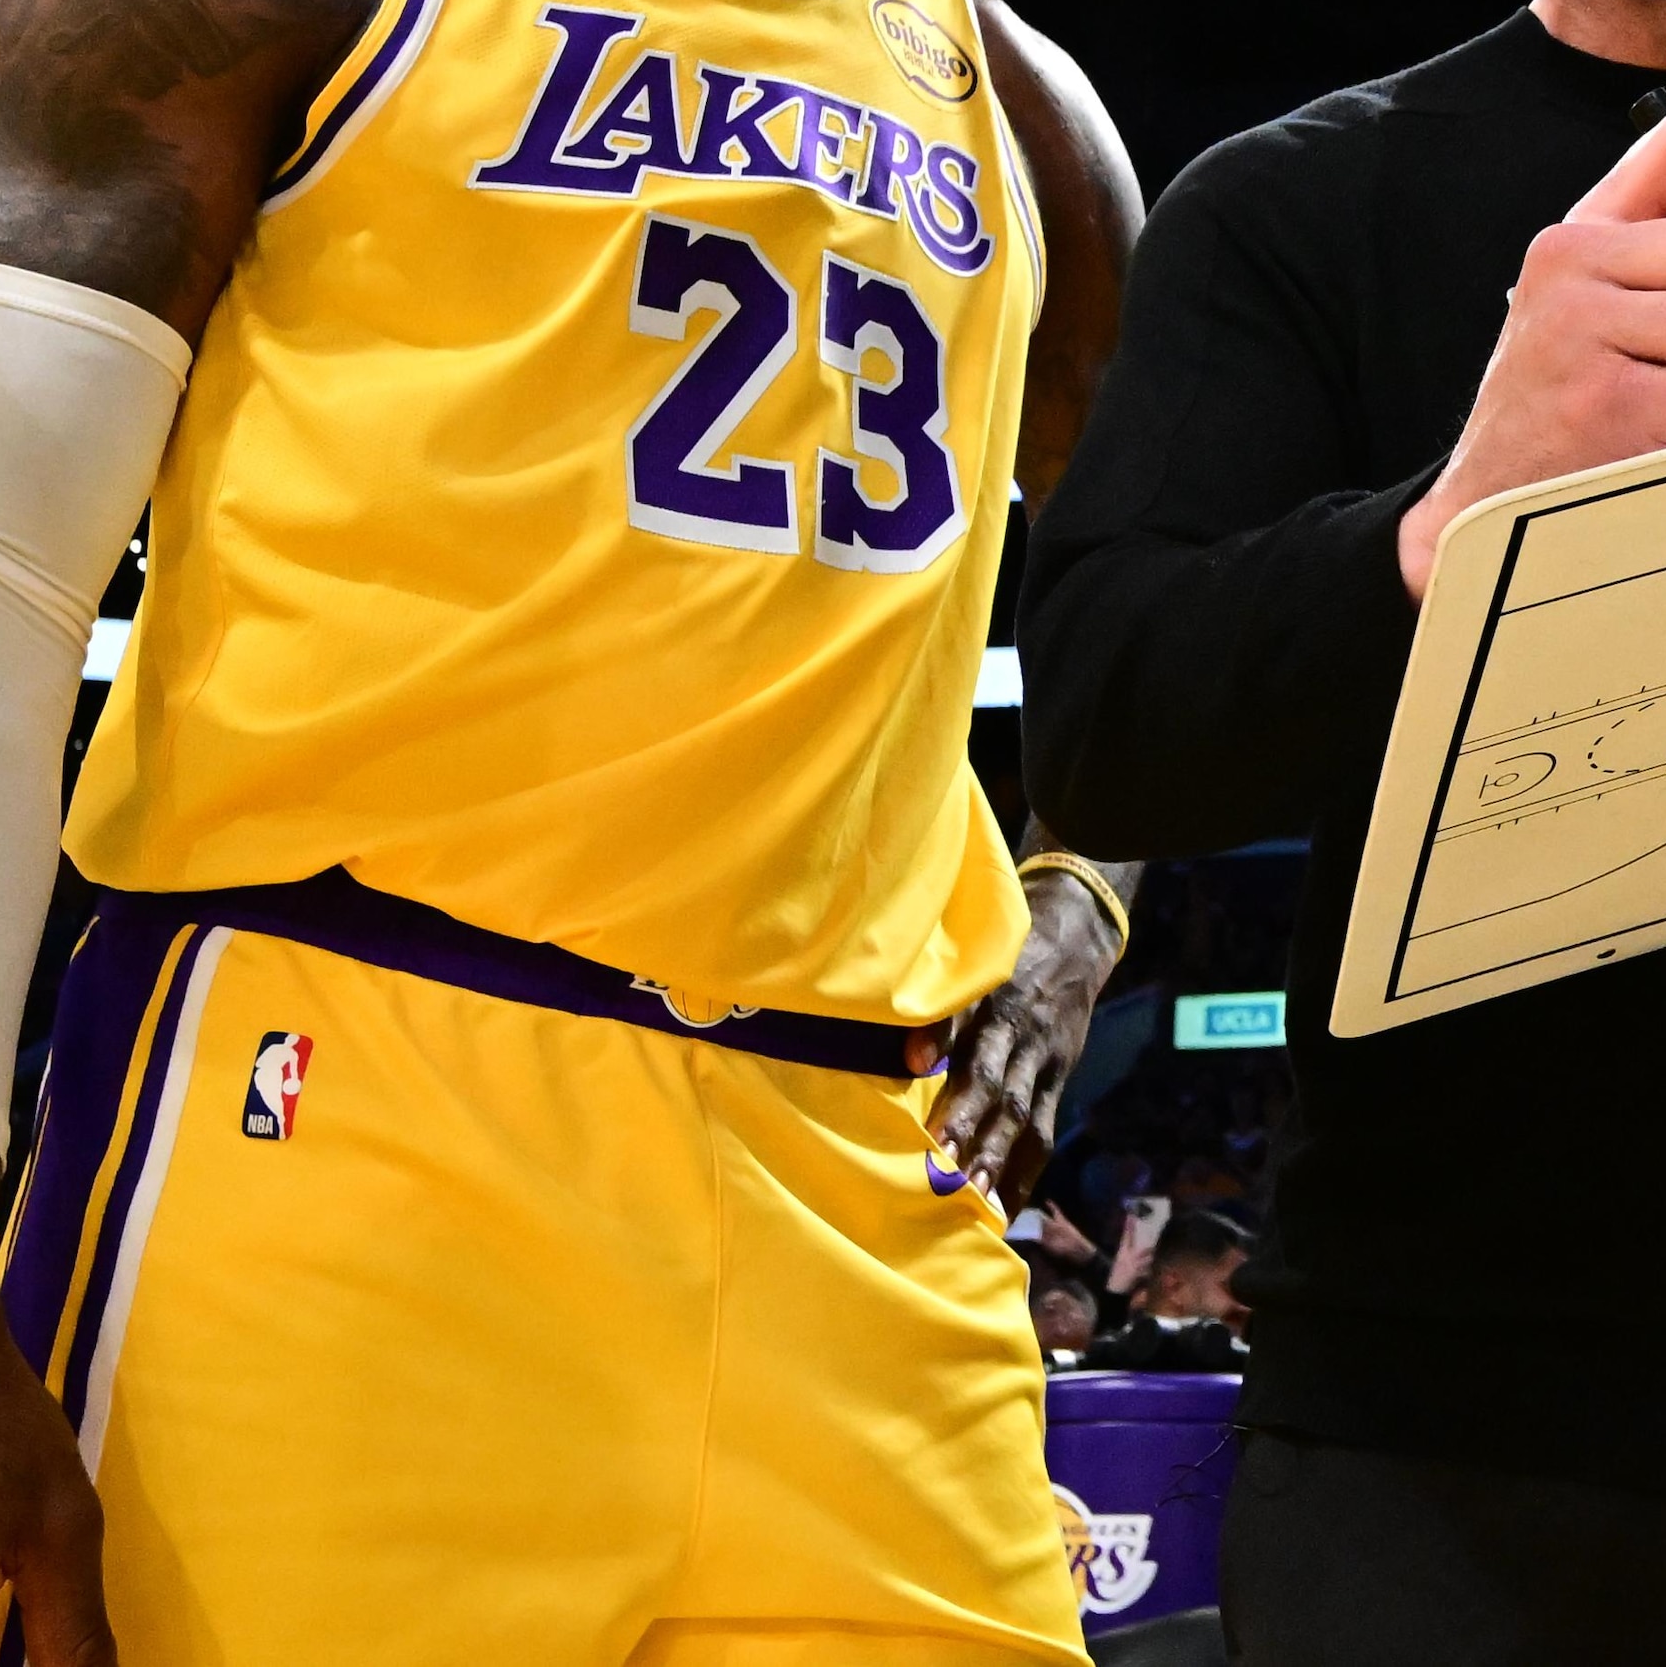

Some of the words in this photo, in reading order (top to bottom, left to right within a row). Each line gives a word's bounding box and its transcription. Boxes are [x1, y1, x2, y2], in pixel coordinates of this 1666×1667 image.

[881, 12, 968, 80] bibigo
[467, 2, 992, 276] LAKERS
[625, 210, 969, 575] 23
[247, 1113, 274, 1135] NBA
